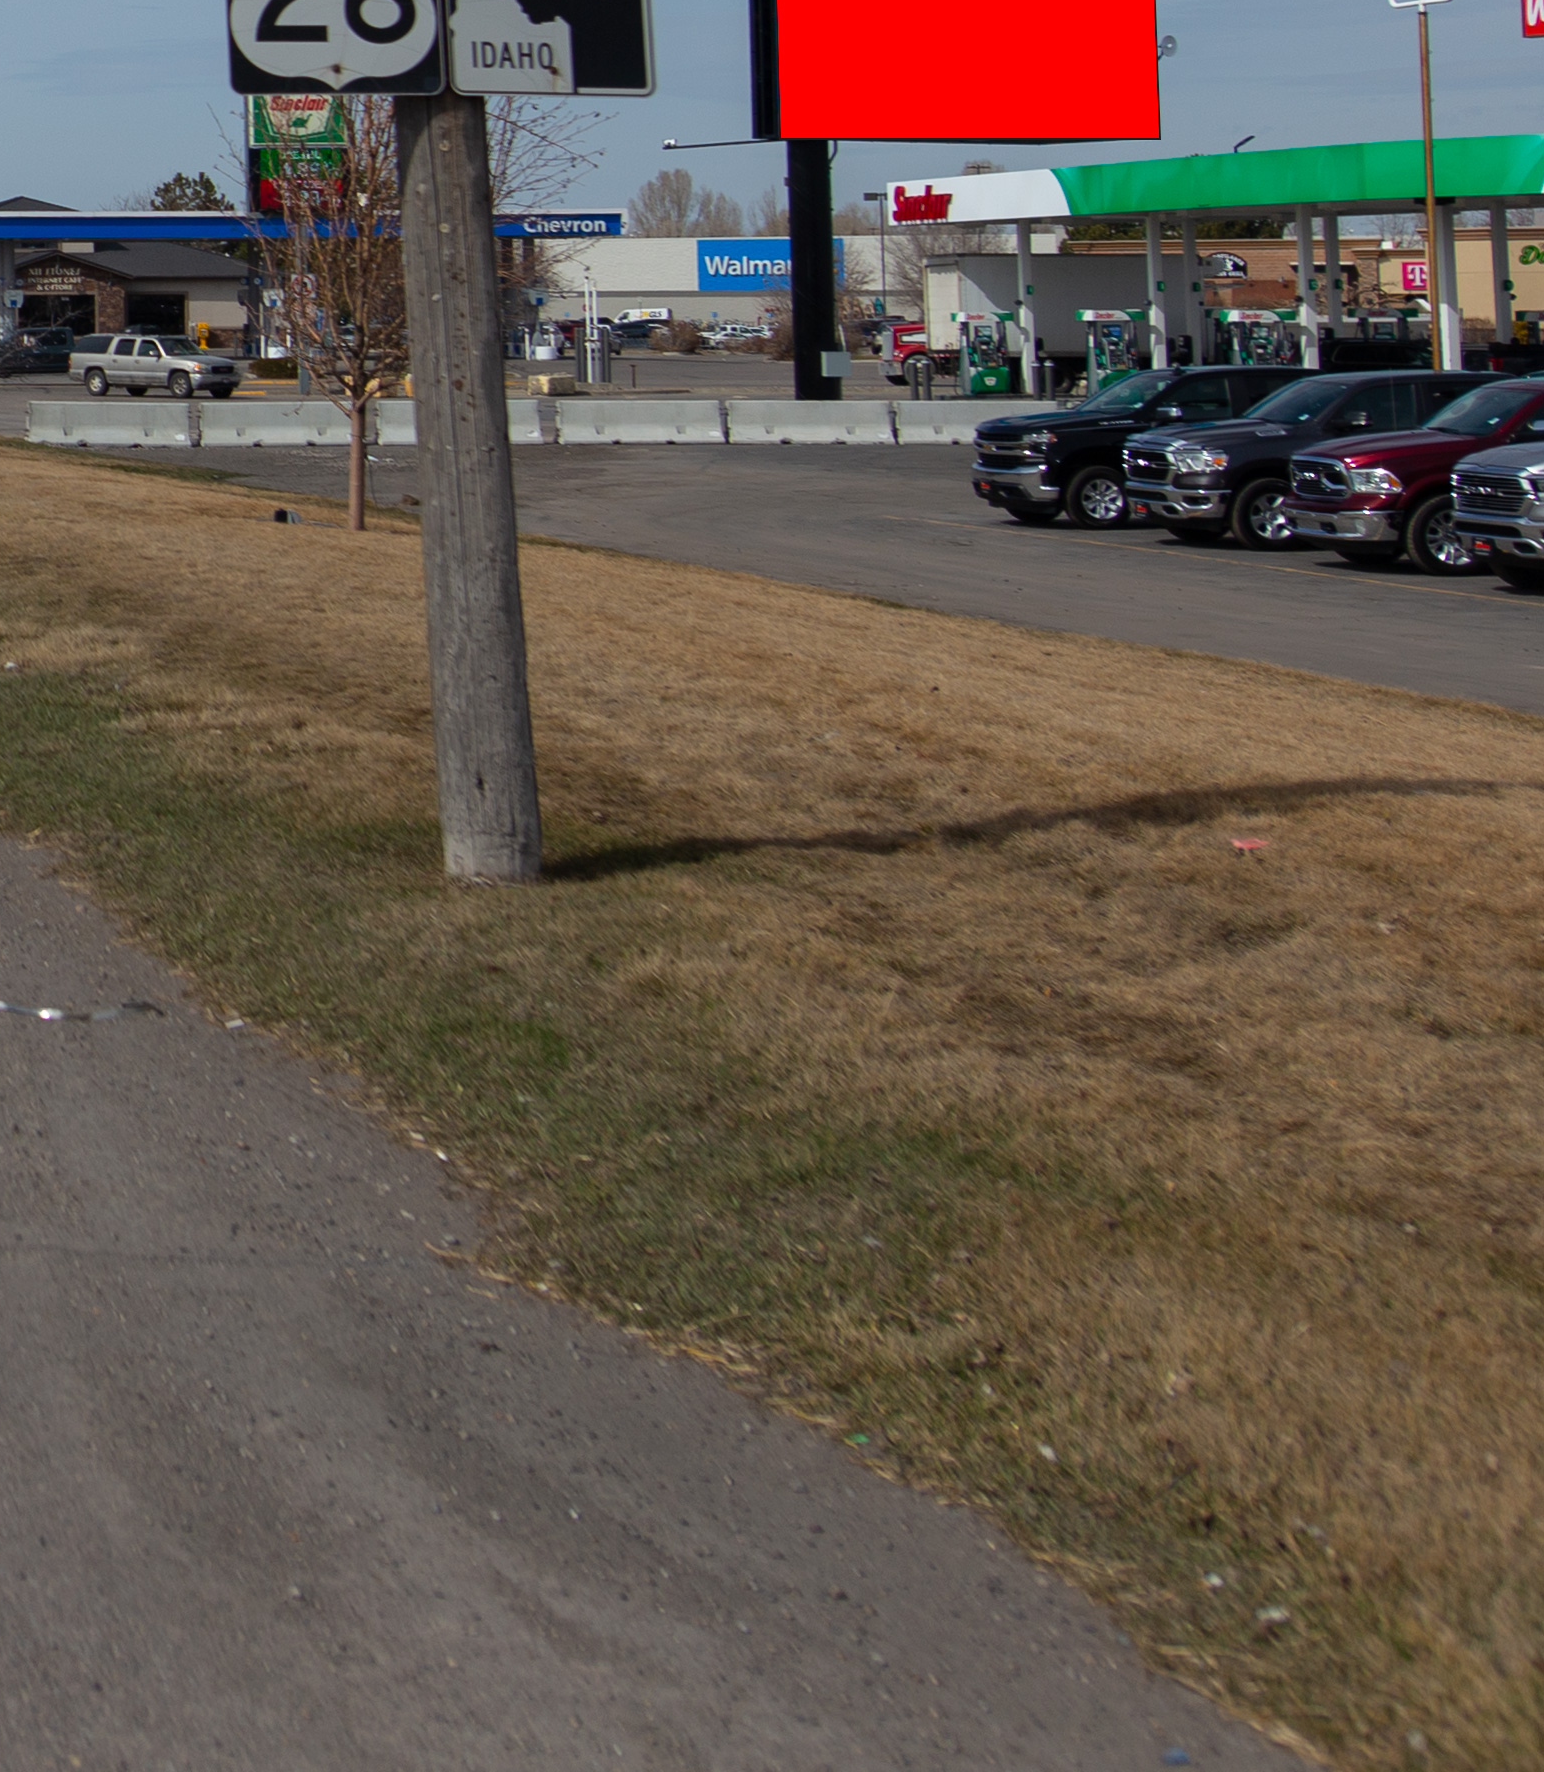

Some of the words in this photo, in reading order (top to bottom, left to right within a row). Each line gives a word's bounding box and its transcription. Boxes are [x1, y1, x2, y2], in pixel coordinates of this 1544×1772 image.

[471, 39, 555, 71] IDAHO
[892, 184, 953, 222] Sinclair
[523, 217, 607, 233] Chevron
[704, 255, 792, 276] Walma
